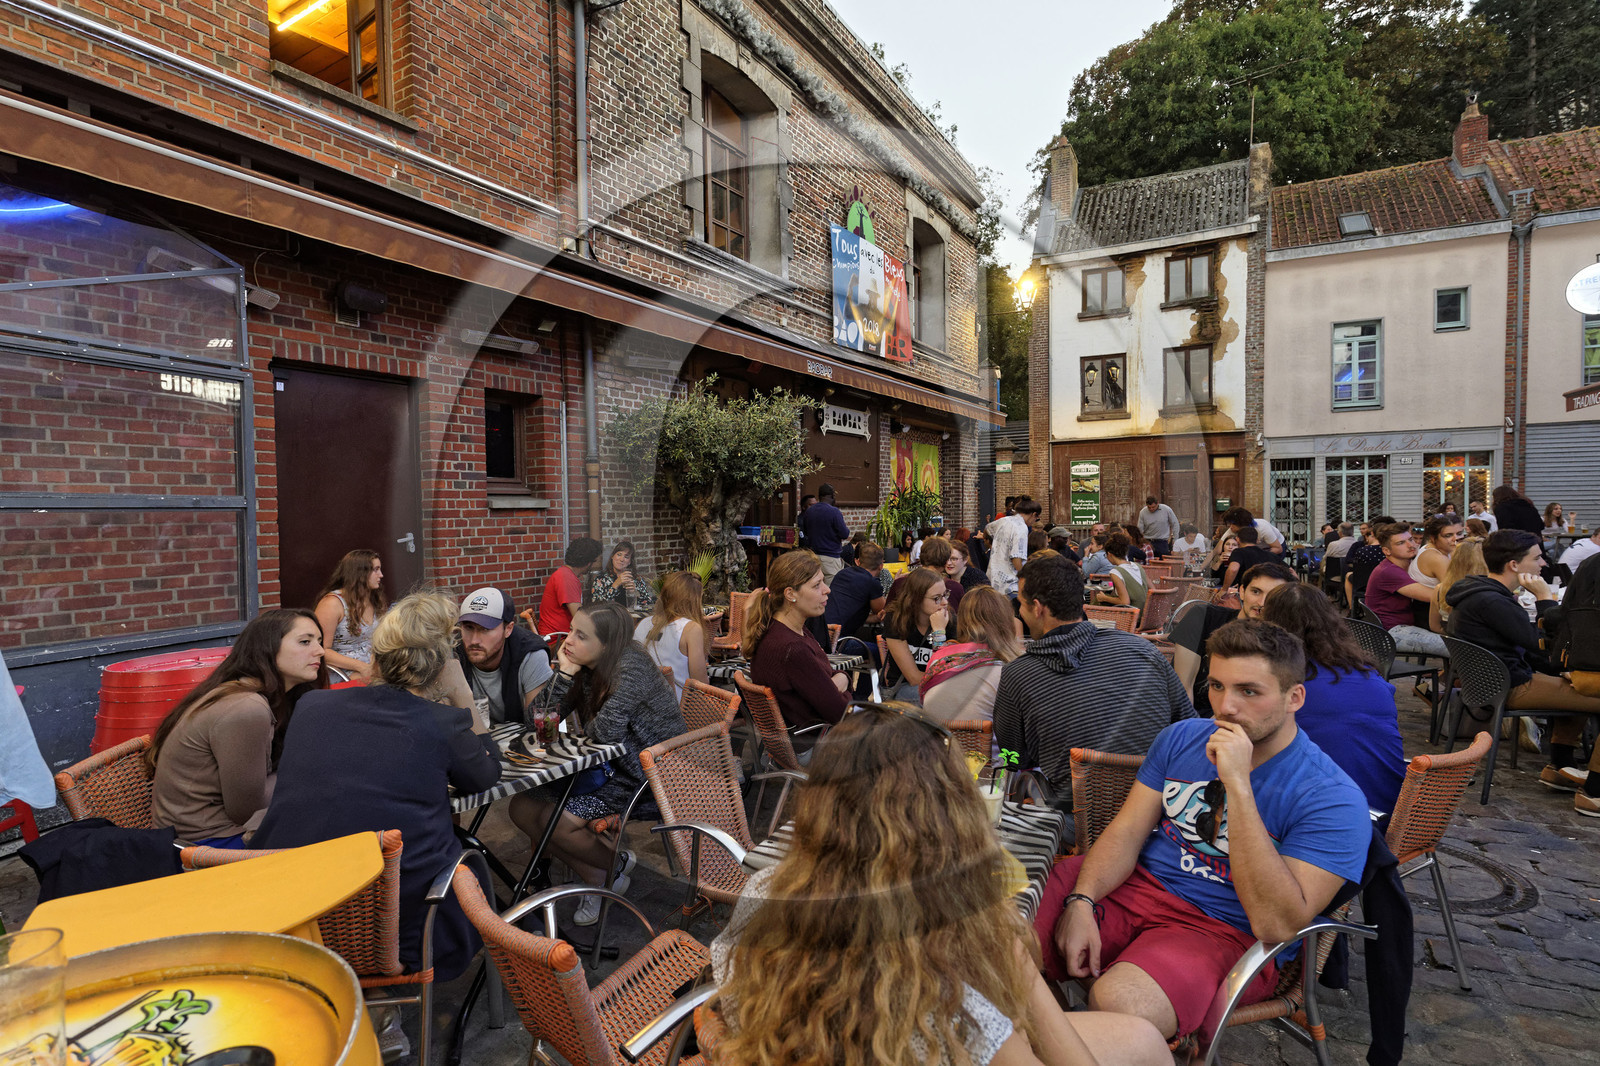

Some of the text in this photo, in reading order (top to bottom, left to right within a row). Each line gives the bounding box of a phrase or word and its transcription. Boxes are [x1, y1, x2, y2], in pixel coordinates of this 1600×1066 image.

[832, 228, 858, 260] Tous
[860, 248, 875, 264] avec
[884, 255, 904, 282] Bleus
[1579, 274, 1600, 287] TRE
[863, 317, 880, 337] 2018
[887, 334, 908, 359] BAR
[806, 359, 833, 379] BAOBAR
[1573, 391, 1600, 409] TRADING
[832, 410, 862, 430] BAOBAR
[1344, 434, 1392, 453] Diable
